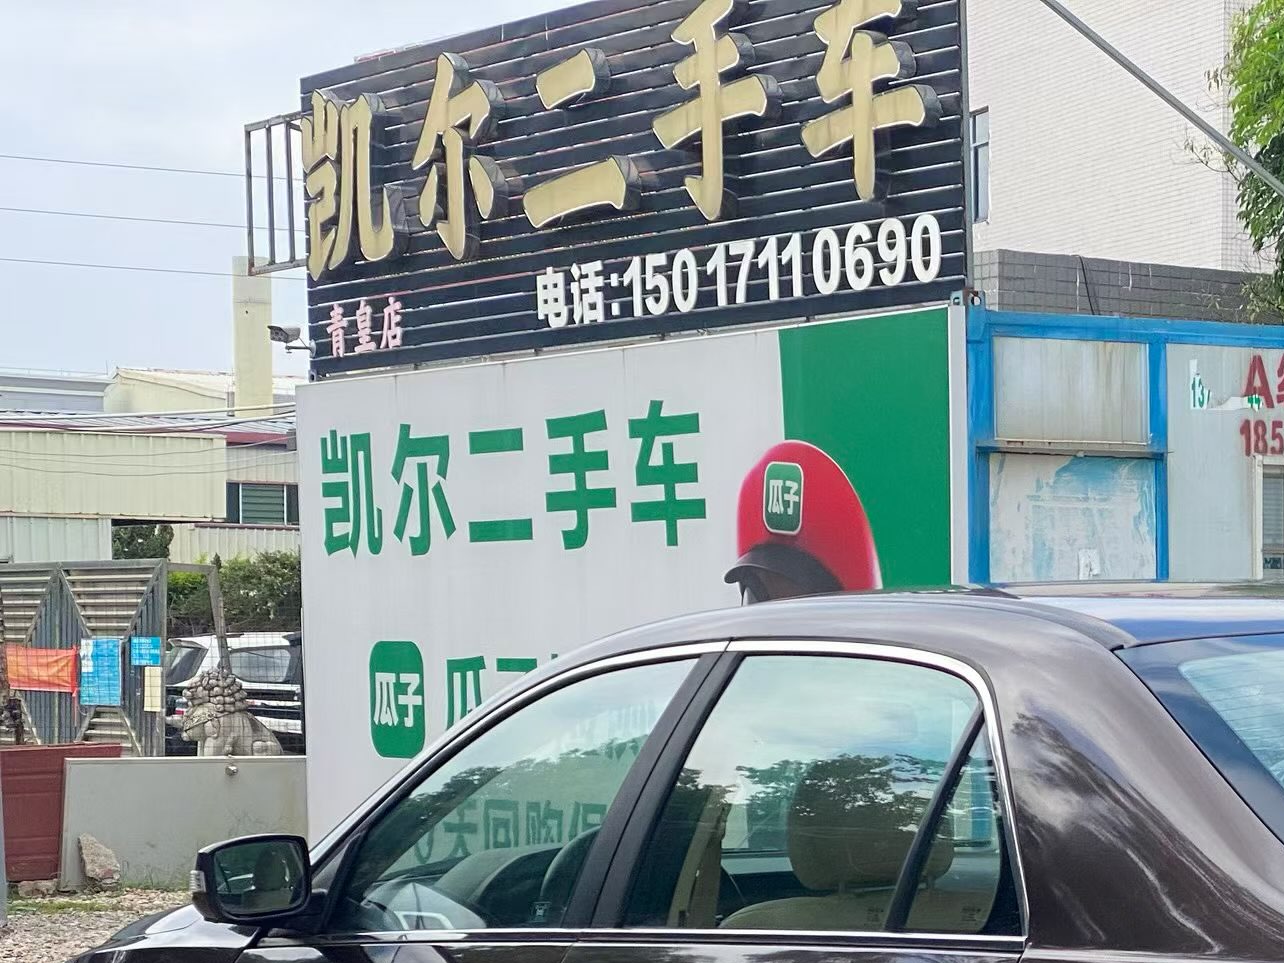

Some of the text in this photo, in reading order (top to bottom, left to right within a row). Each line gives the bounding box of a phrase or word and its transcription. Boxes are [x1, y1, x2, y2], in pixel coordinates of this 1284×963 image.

[302, 0, 934, 281] 凯尔二手车
[326, 296, 403, 358] 青皇店
[1240, 419, 1284, 456] 185
[321, 400, 706, 557] 凯尔二手车
[768, 479, 800, 515] 瓜子
[373, 673, 423, 728] 瓜子
